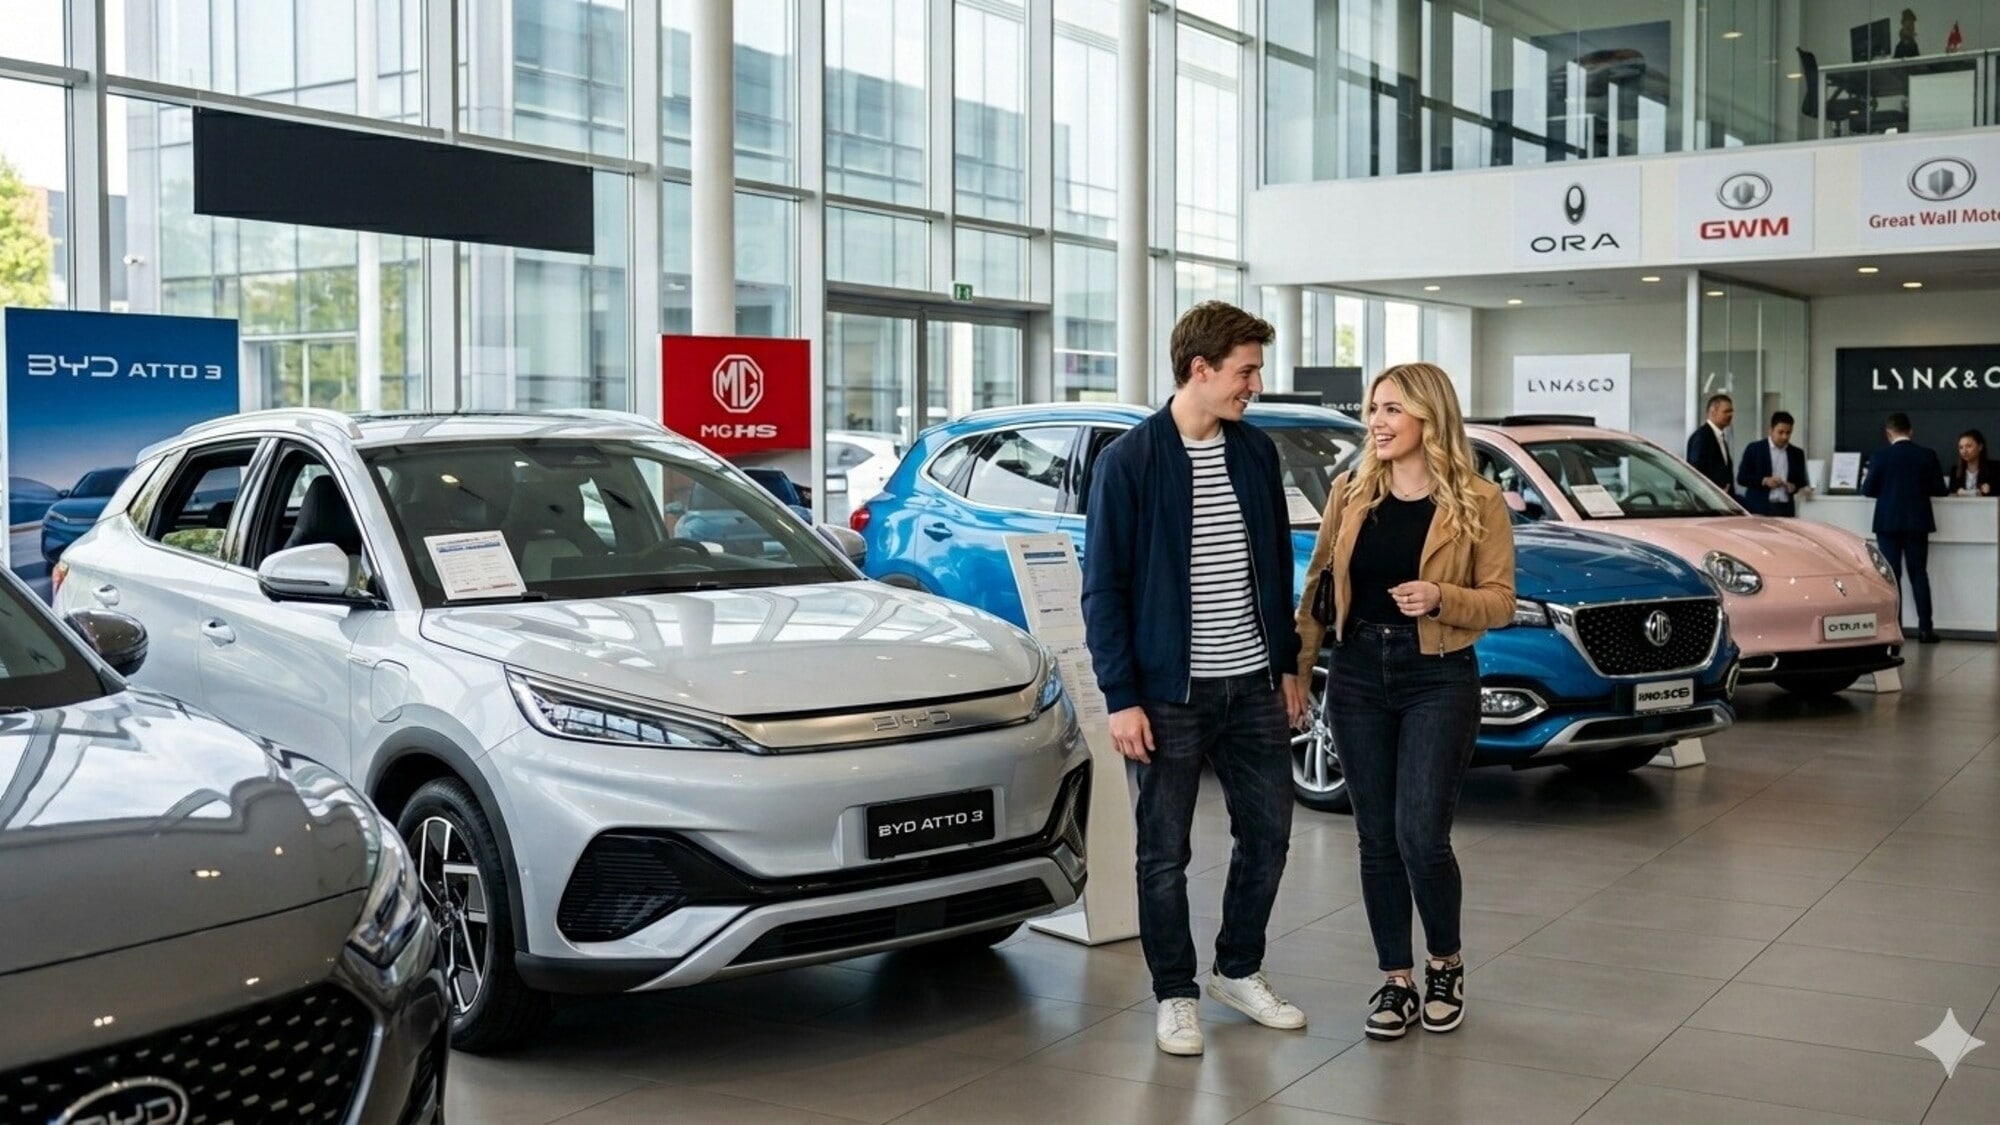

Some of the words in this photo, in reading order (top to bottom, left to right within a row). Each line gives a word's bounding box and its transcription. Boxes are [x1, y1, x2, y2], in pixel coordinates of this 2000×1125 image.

[1700, 217, 1789, 240] GWM
[1869, 213, 1915, 229] Great
[1920, 209, 1957, 225] Wall
[1530, 233, 1620, 253] ORA
[27, 354, 119, 378] BYD
[128, 363, 198, 379] ATTO
[204, 364, 222, 380] 3
[717, 360, 760, 408] MG
[872, 710, 951, 732] BYD
[878, 820, 917, 838] BYD
[921, 812, 967, 831] ATTO
[971, 809, 984, 823] 3
